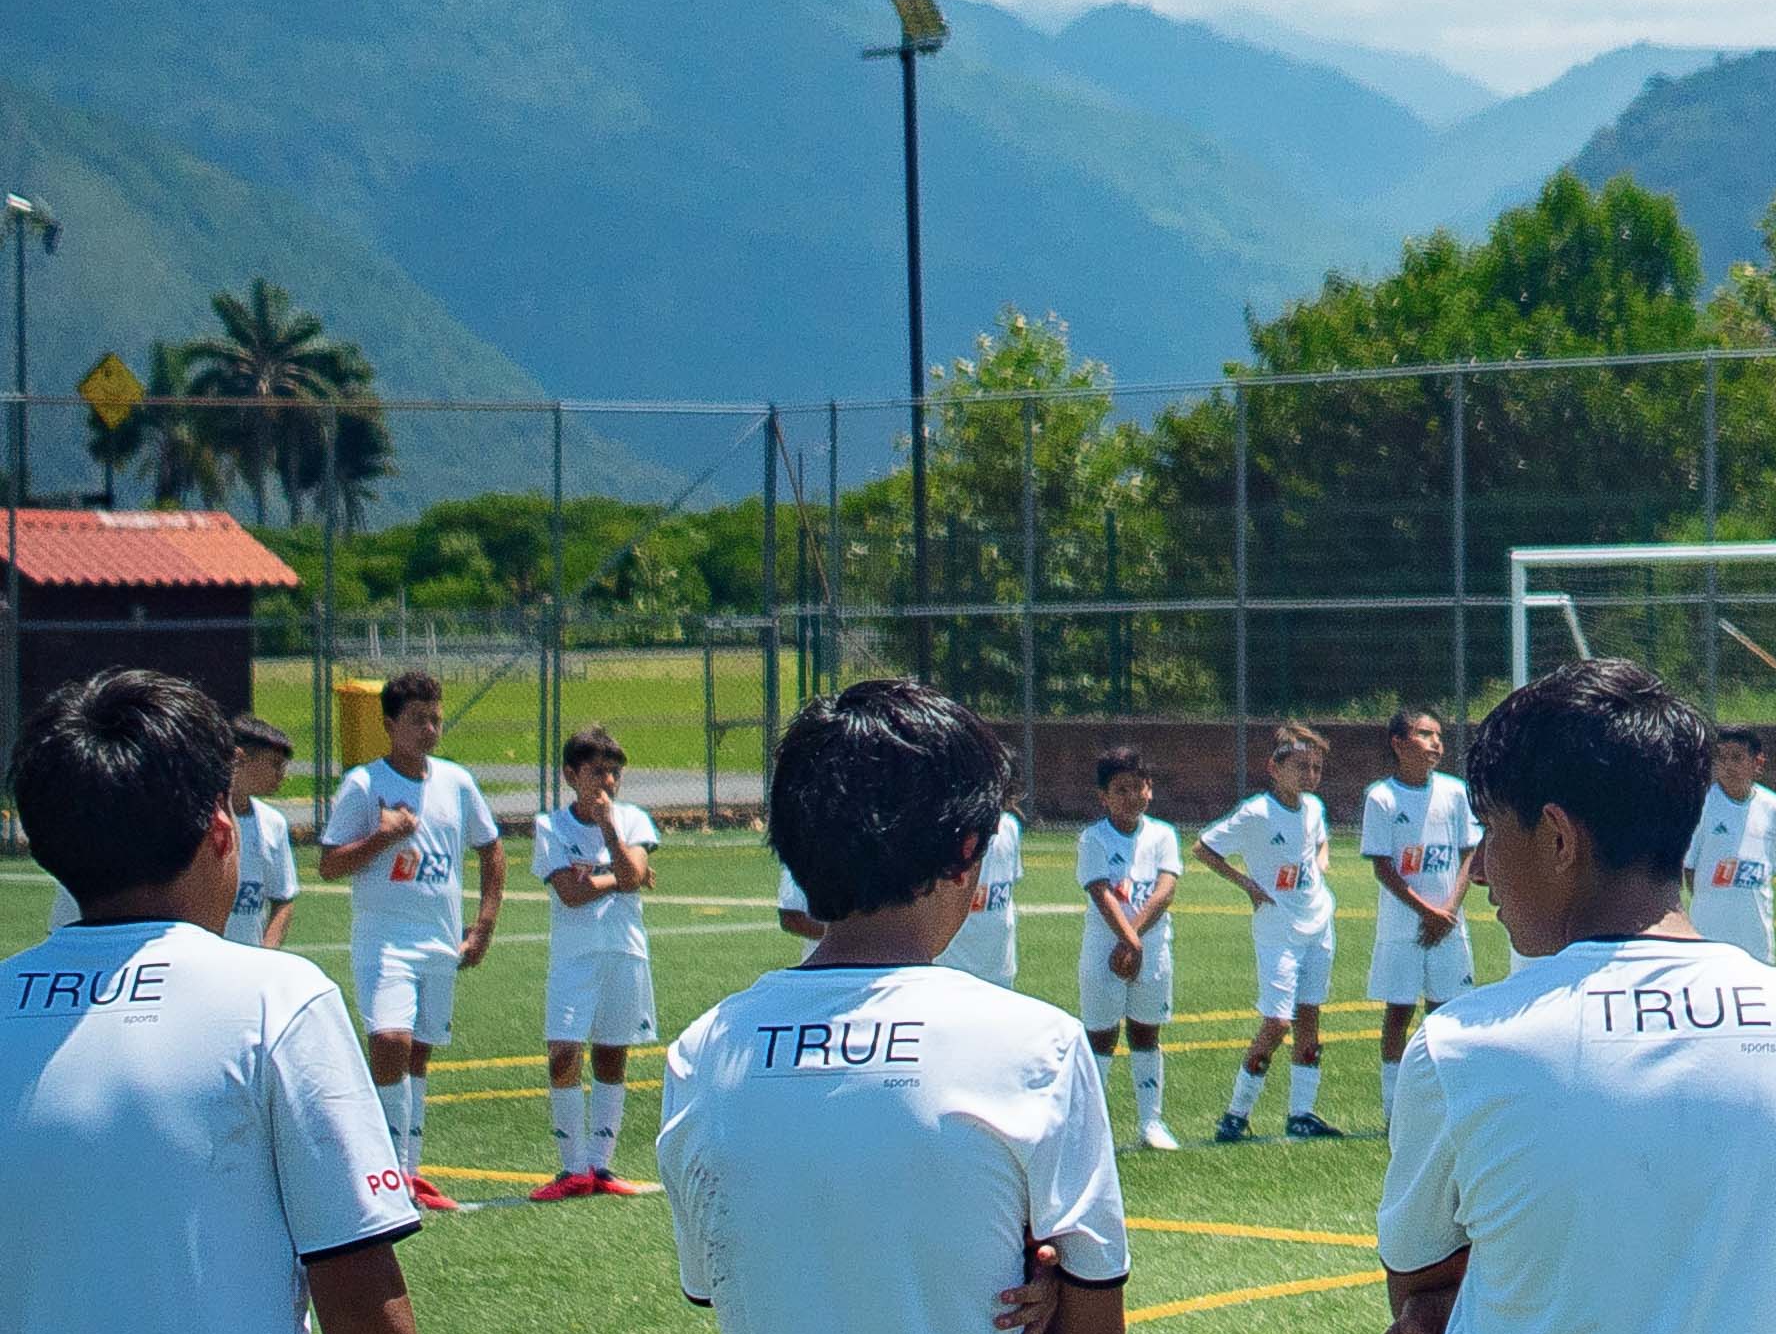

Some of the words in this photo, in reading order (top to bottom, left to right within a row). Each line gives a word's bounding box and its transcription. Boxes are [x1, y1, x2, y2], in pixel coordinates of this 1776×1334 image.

[16, 962, 171, 1010] TRUE
[123, 1013, 159, 1025] sports
[1586, 987, 1772, 1033] TRUE
[757, 1021, 925, 1069] TRUE
[1740, 1041, 1776, 1054] sports
[883, 1076, 921, 1089] sports
